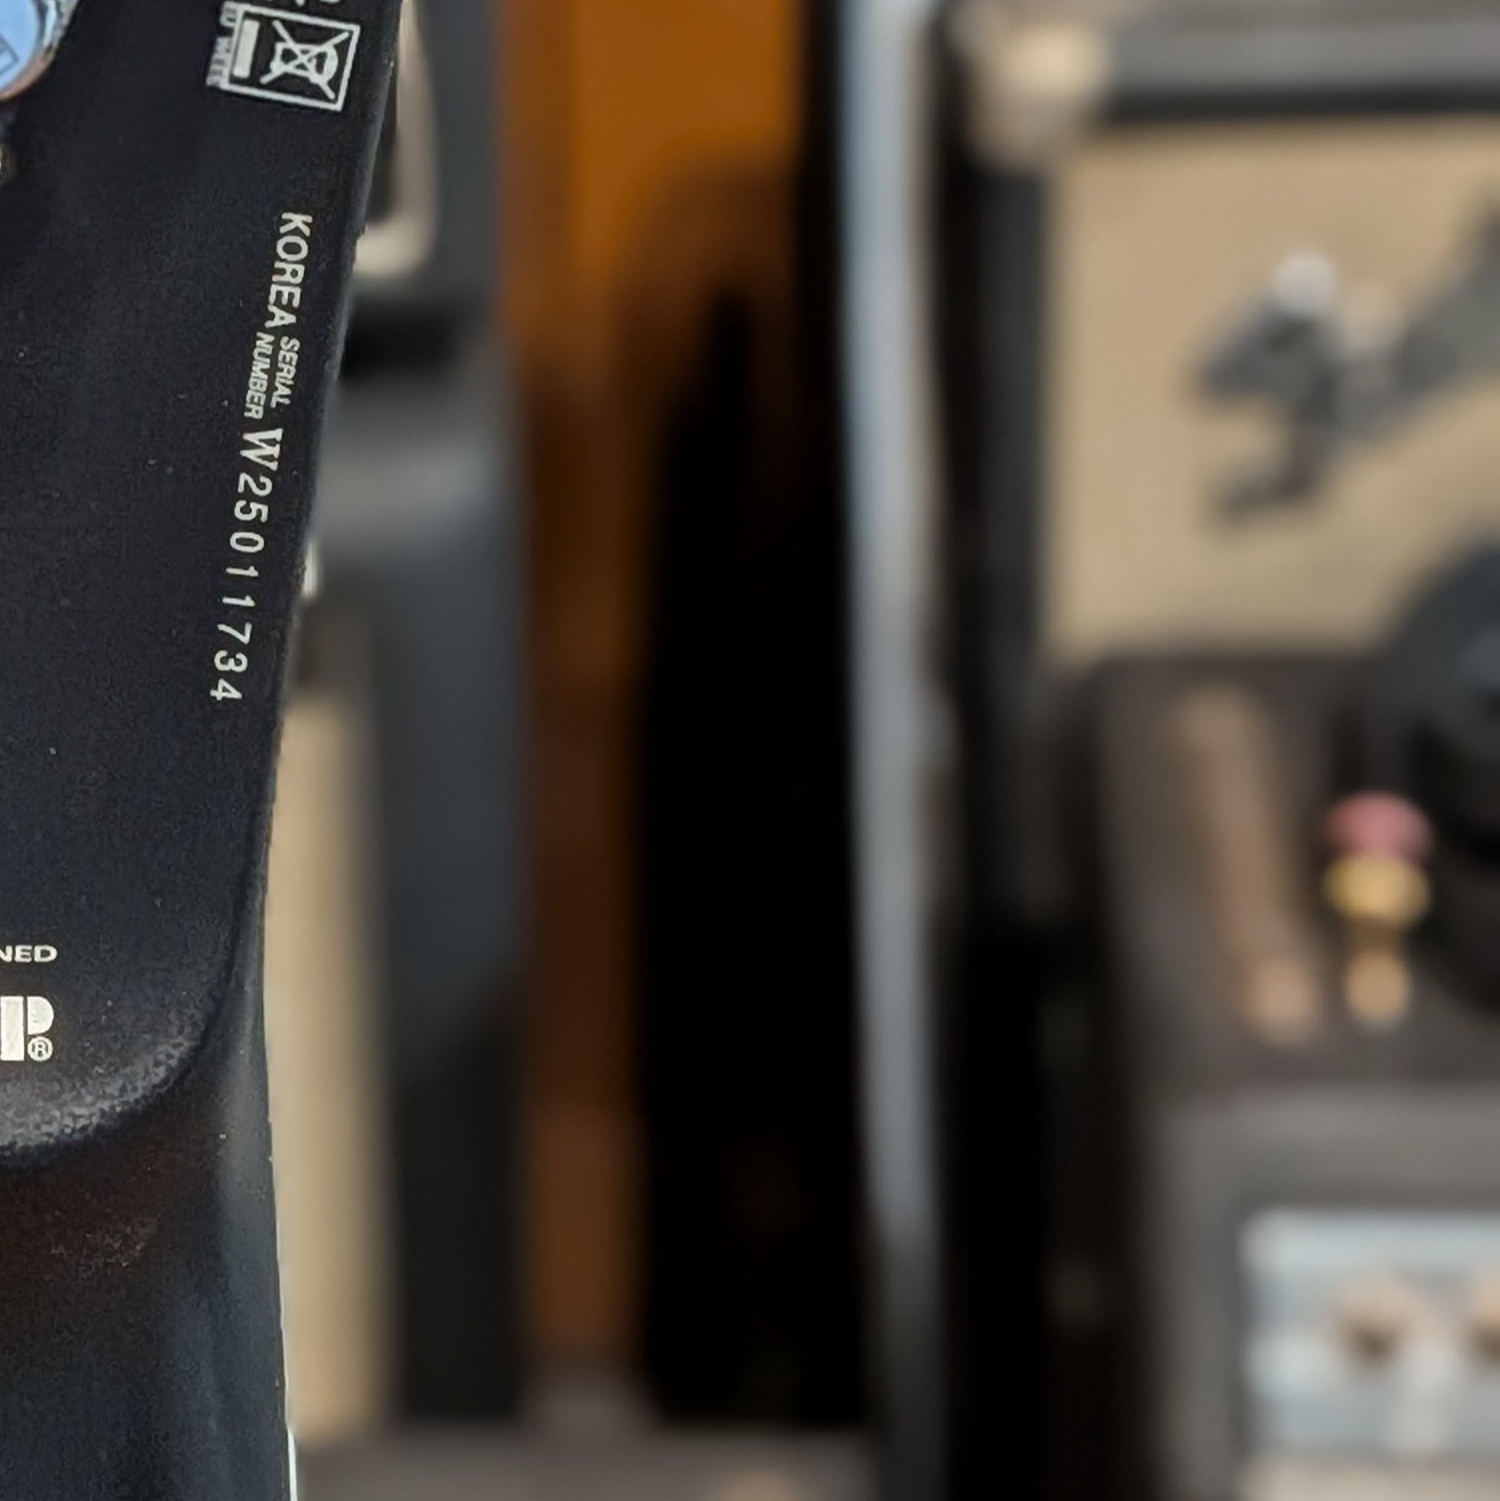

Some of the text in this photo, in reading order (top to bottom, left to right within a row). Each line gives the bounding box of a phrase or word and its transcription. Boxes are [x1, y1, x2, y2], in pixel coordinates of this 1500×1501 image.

[265, 211, 312, 329] KOREA
[244, 332, 275, 420] NUMBER
[270, 336, 300, 408] SERIAL
[210, 427, 284, 702] W25011734
